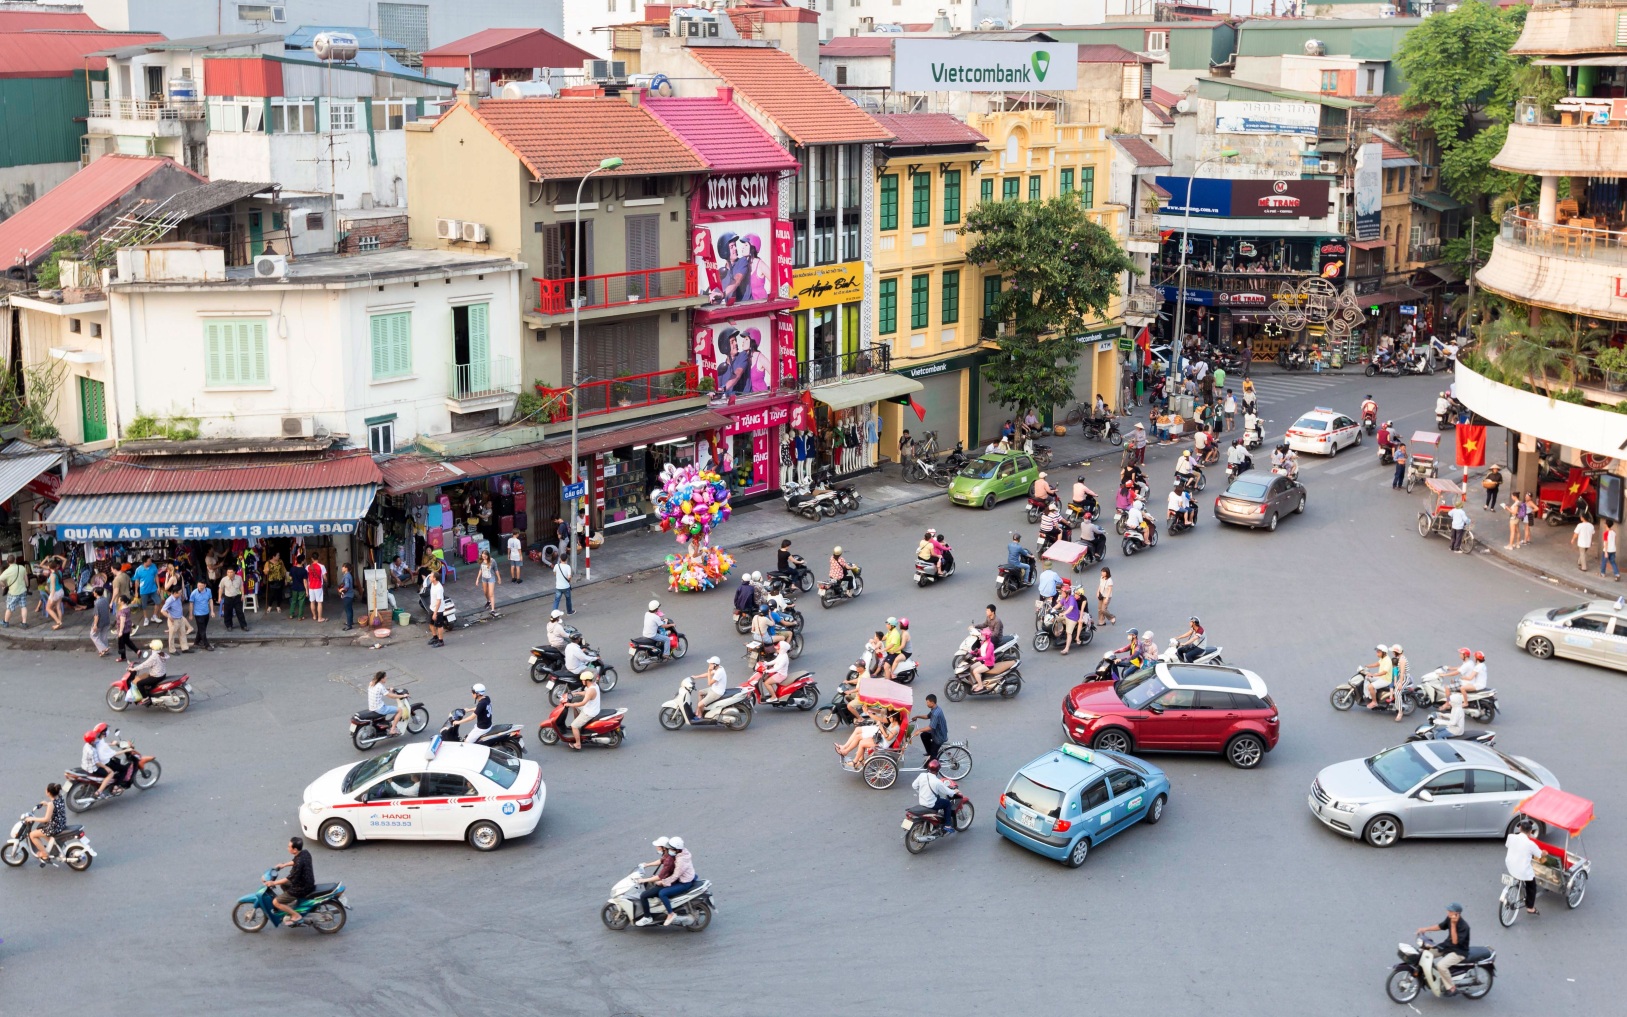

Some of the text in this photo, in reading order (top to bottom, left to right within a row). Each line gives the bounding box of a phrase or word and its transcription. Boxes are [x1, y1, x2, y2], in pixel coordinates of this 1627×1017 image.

[931, 63, 1031, 82] Vietcombank
[707, 172, 768, 209] NÓN SƠN
[1259, 197, 1300, 207] MÊ TRANG
[776, 229, 790, 240] MUA
[781, 242, 786, 253] 1
[777, 254, 792, 266] TẶNG
[784, 268, 789, 278] 1
[778, 321, 793, 332] MUA
[784, 334, 789, 345] 1
[1100, 342, 1111, 350] ATM
[788, 358, 792, 369] 1
[911, 363, 947, 377] Vietcombank
[741, 414, 761, 427] TẶNG
[761, 409, 768, 425] 1
[758, 439, 763, 450] 1
[758, 464, 763, 475] 1
[64, 525, 113, 540] QUÁN
[118, 526, 142, 539] ÁO
[147, 525, 179, 538] TRẺ
[184, 526, 209, 538] EM
[228, 525, 262, 537] 113
[267, 522, 314, 536] HÀNG
[319, 521, 353, 533] ĐÀO
